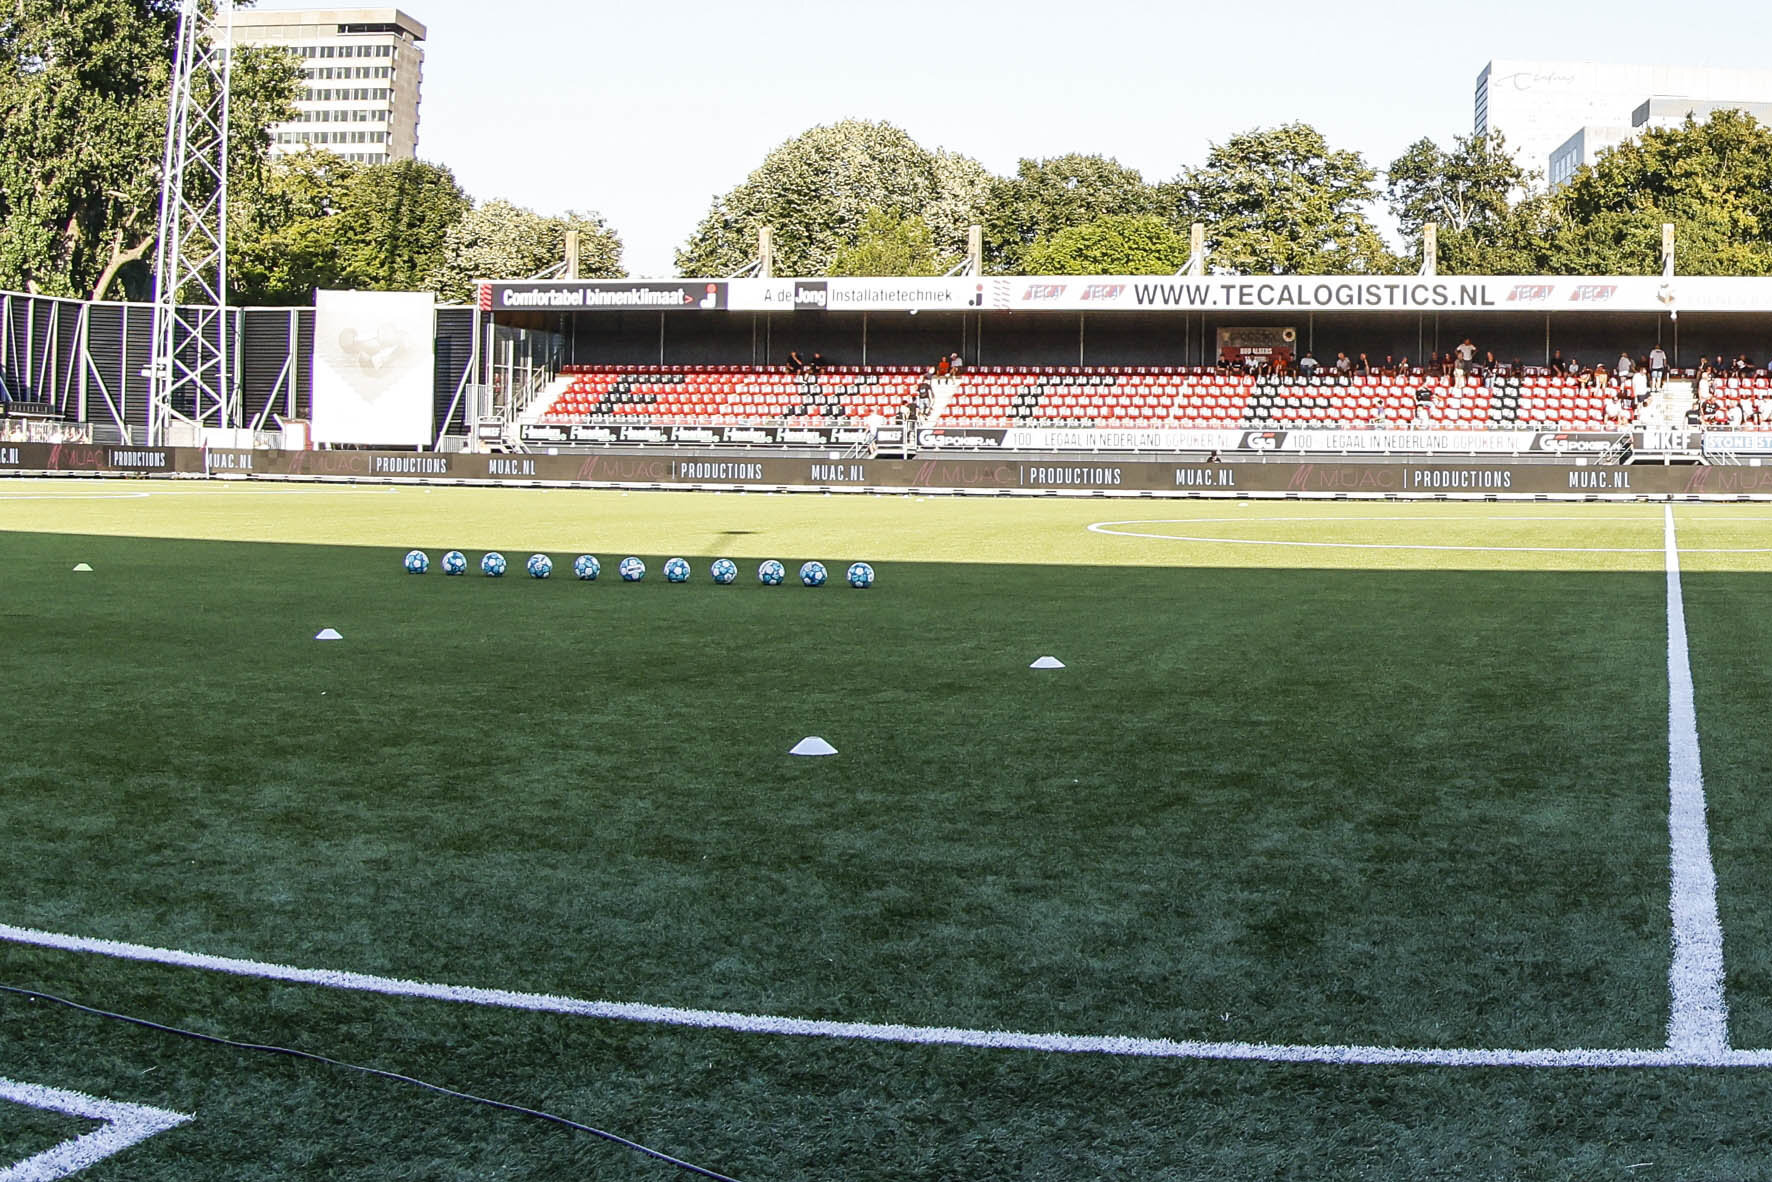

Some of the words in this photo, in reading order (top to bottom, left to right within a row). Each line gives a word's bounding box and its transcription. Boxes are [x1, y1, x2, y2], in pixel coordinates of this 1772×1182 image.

[503, 288, 583, 306] Comfortabel
[586, 287, 685, 306] binnenklimaat
[796, 287, 826, 306] Jong
[832, 288, 952, 302] Installatietechniek
[1029, 284, 1062, 300] TECA
[1086, 284, 1119, 300] TECA
[1134, 284, 1495, 306] WWW.TECALOGISTICS.NL
[1045, 430, 1081, 446] LEGAAL
[1086, 430, 1096, 446] IN
[1099, 431, 1160, 448] NEDERLAND
[1326, 433, 1366, 449] LEGAAL
[1370, 433, 1381, 449] IN
[1384, 433, 1449, 449] NEDERLAND
[114, 451, 166, 467] PRODUCTIONS
[376, 456, 447, 474] PRODUCTIONS
[488, 459, 536, 476] MUAC.NL
[681, 463, 762, 480] PRODUCTIONS
[812, 464, 865, 482] MUAC.NL
[1030, 468, 1121, 485] PRODUCTIONS
[1176, 469, 1235, 486] MUAC.NL
[1414, 470, 1511, 488] PRODUCTIONS
[1569, 471, 1631, 489] MUAC.NL
